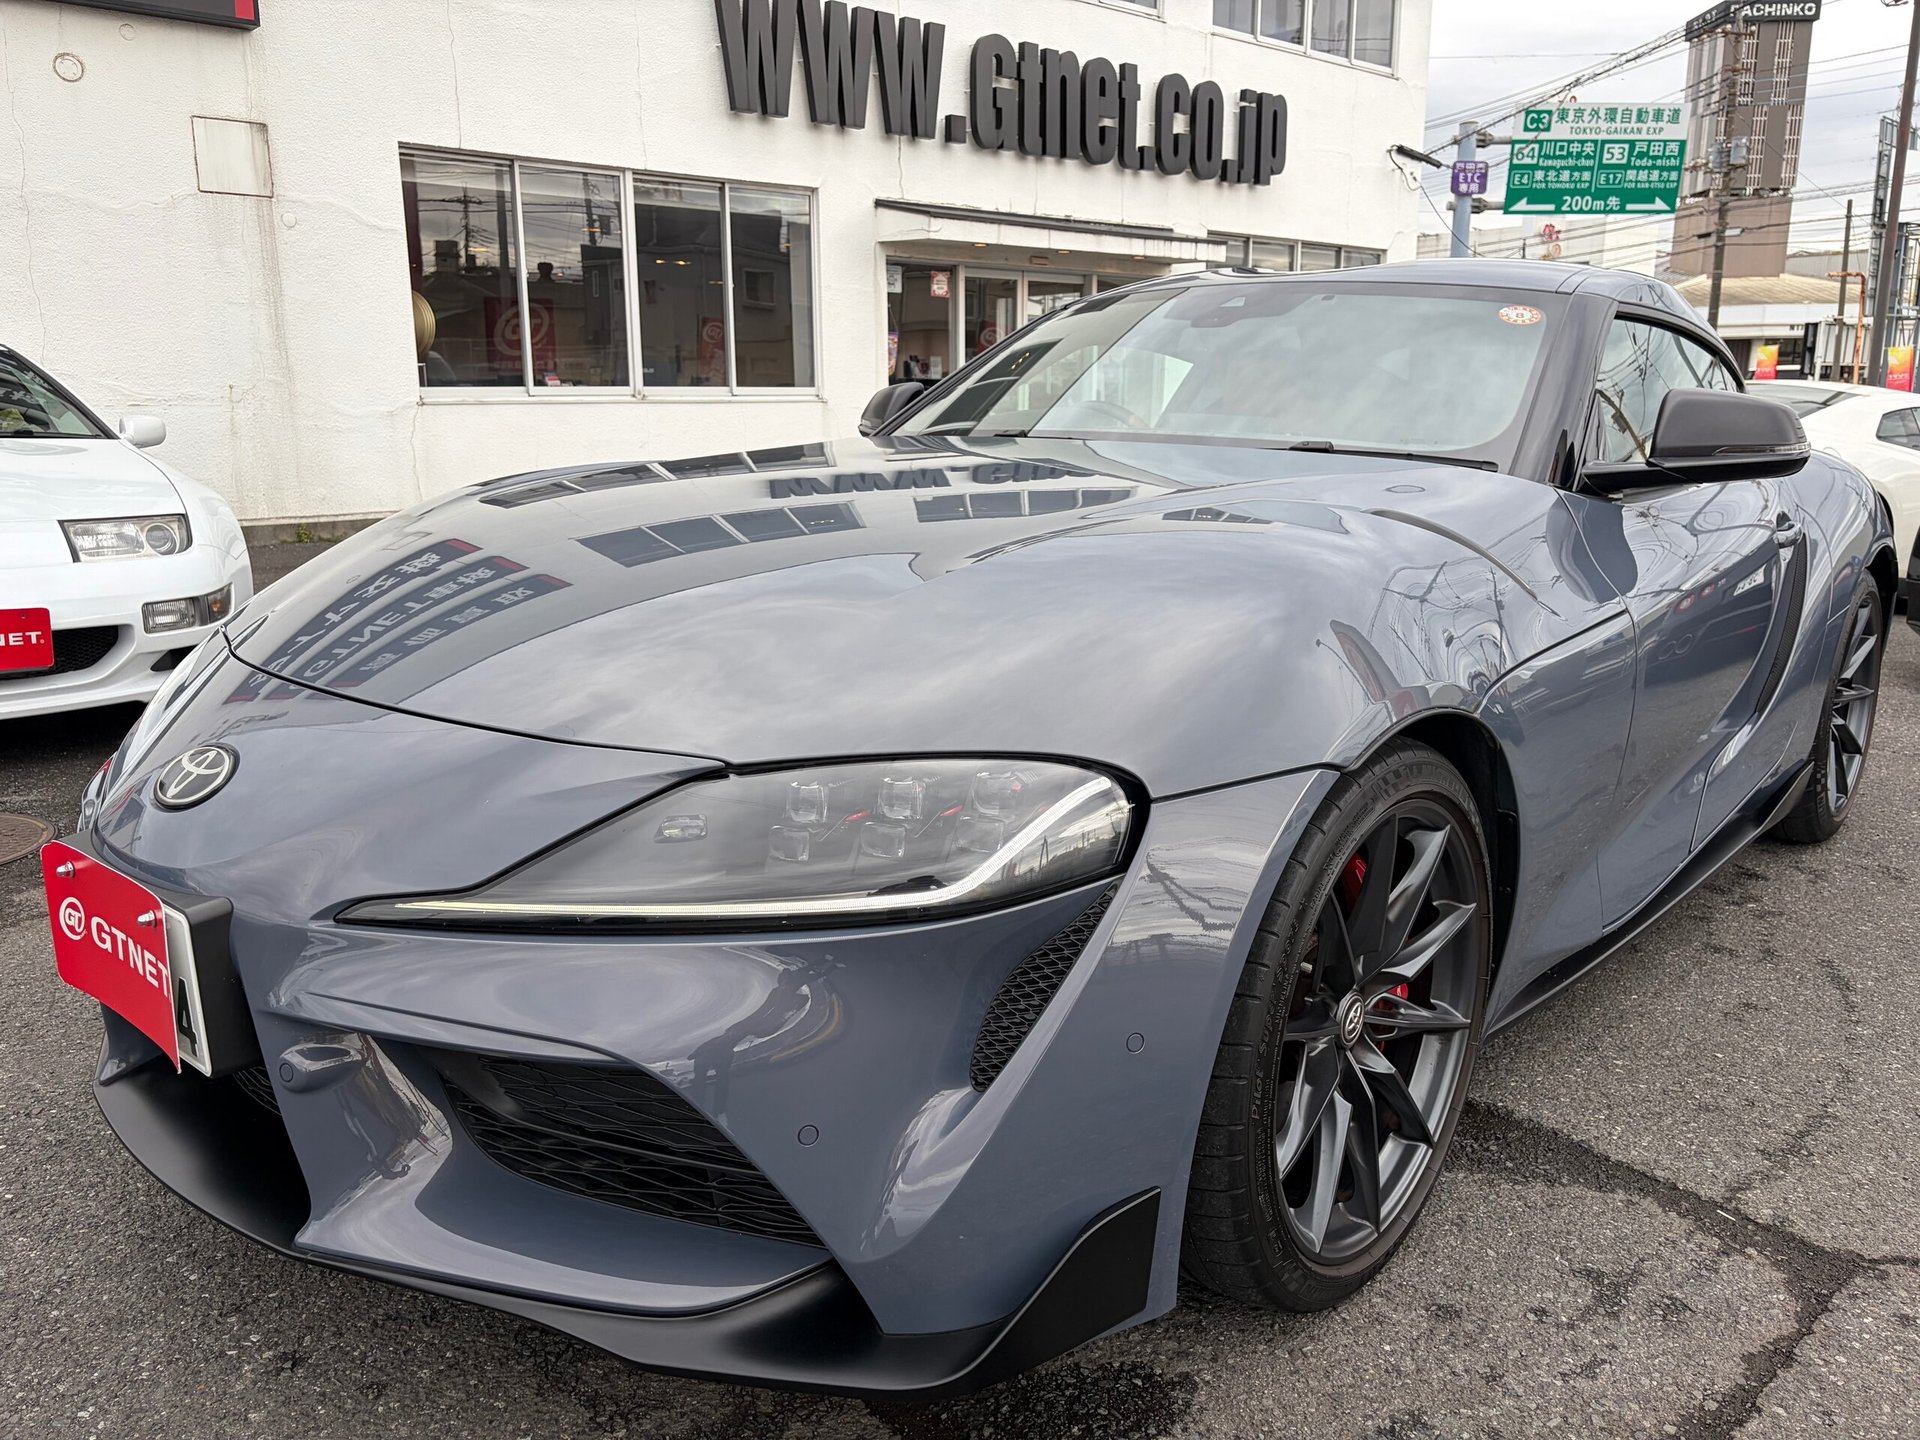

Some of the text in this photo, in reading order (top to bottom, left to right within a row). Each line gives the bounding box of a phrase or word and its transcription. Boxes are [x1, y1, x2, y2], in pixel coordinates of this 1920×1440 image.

[1526, 113, 1550, 129] C3
[1554, 107, 1682, 125] 東京外環自動車道
[1569, 126, 1665, 136] TOKYO-GAIKAN EXP
[1515, 146, 1537, 162] 64
[1540, 141, 1596, 157] 川口中央
[1605, 146, 1627, 161] 53
[1632, 141, 1681, 157] 戸田西
[1630, 157, 1681, 167] Toda-nishi
[1458, 172, 1481, 183] ETC
[1513, 173, 1529, 185] E4
[1600, 173, 1622, 185] E17
[1561, 196, 1621, 211] 200m先
[91, 916, 169, 998] GTNET
